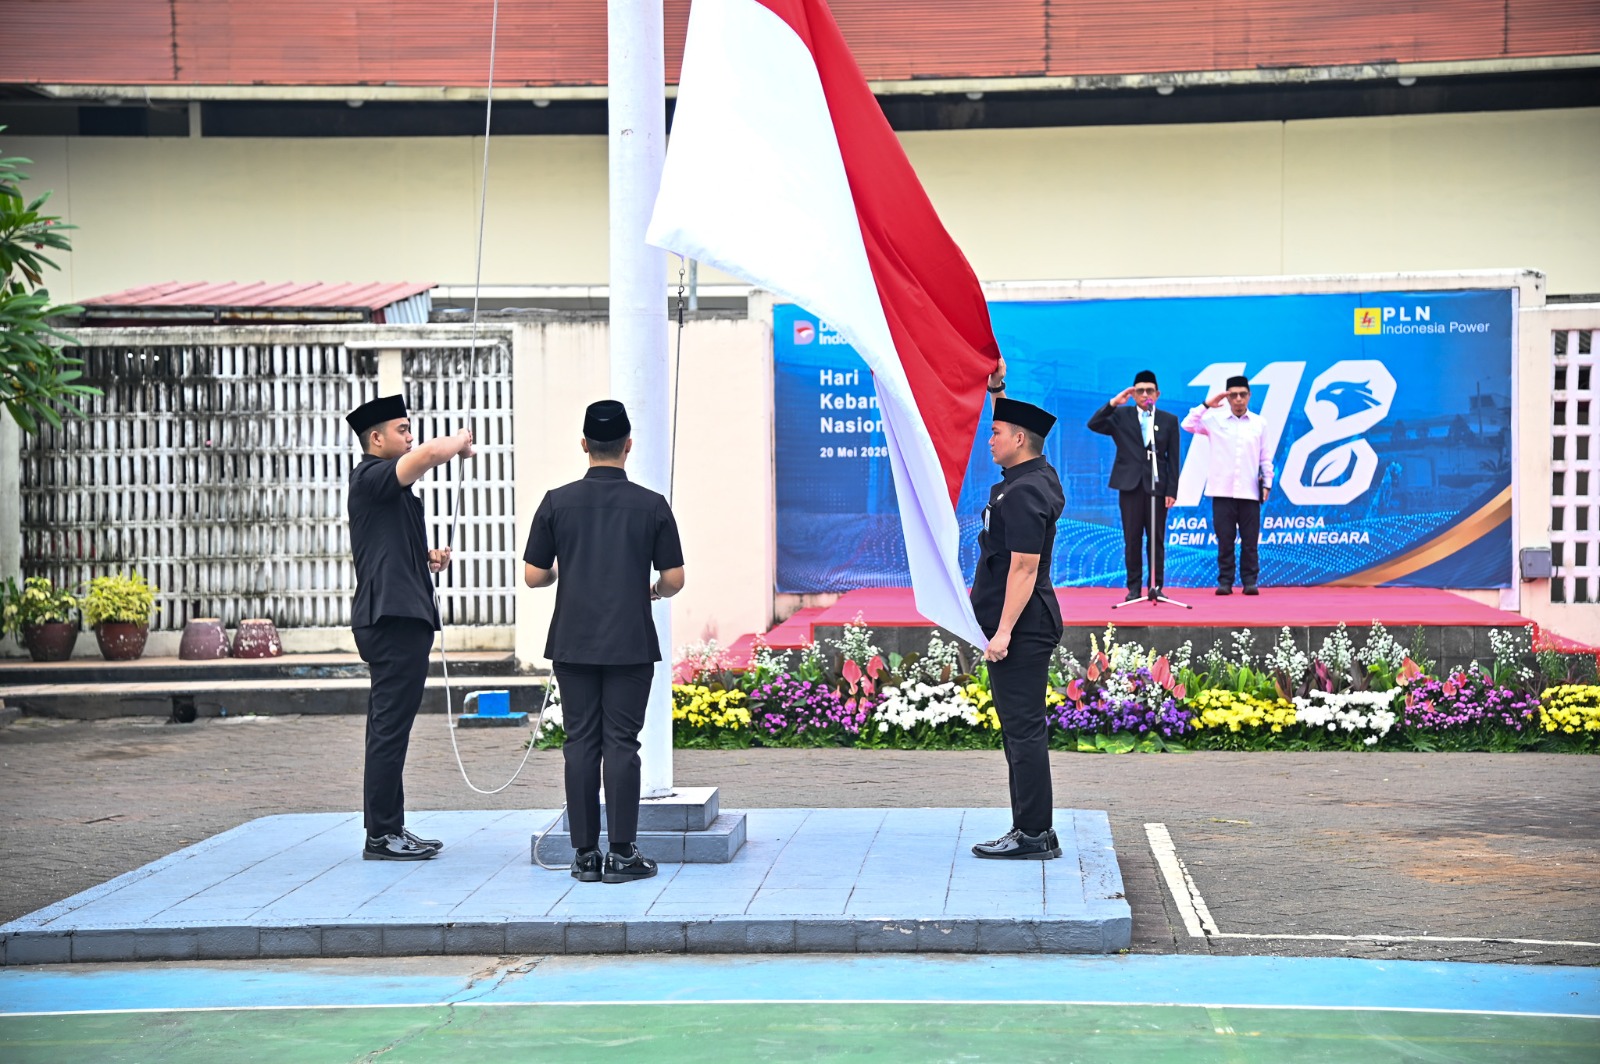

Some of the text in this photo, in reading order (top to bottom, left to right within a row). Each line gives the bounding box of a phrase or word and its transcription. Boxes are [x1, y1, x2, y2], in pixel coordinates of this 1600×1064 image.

[1383, 306, 1431, 322] PLN
[1383, 321, 1491, 335] Indonesia Power
[818, 332, 848, 345] Indo
[820, 369, 859, 386] Hari
[820, 393, 879, 409] Keban
[820, 416, 885, 433] Nasion
[820, 446, 888, 458] 20 Mei 2026
[1168, 516, 1325, 530] JAGA BANGSA
[1169, 533, 1205, 545] DEMI
[1308, 531, 1370, 545] NEGARA
